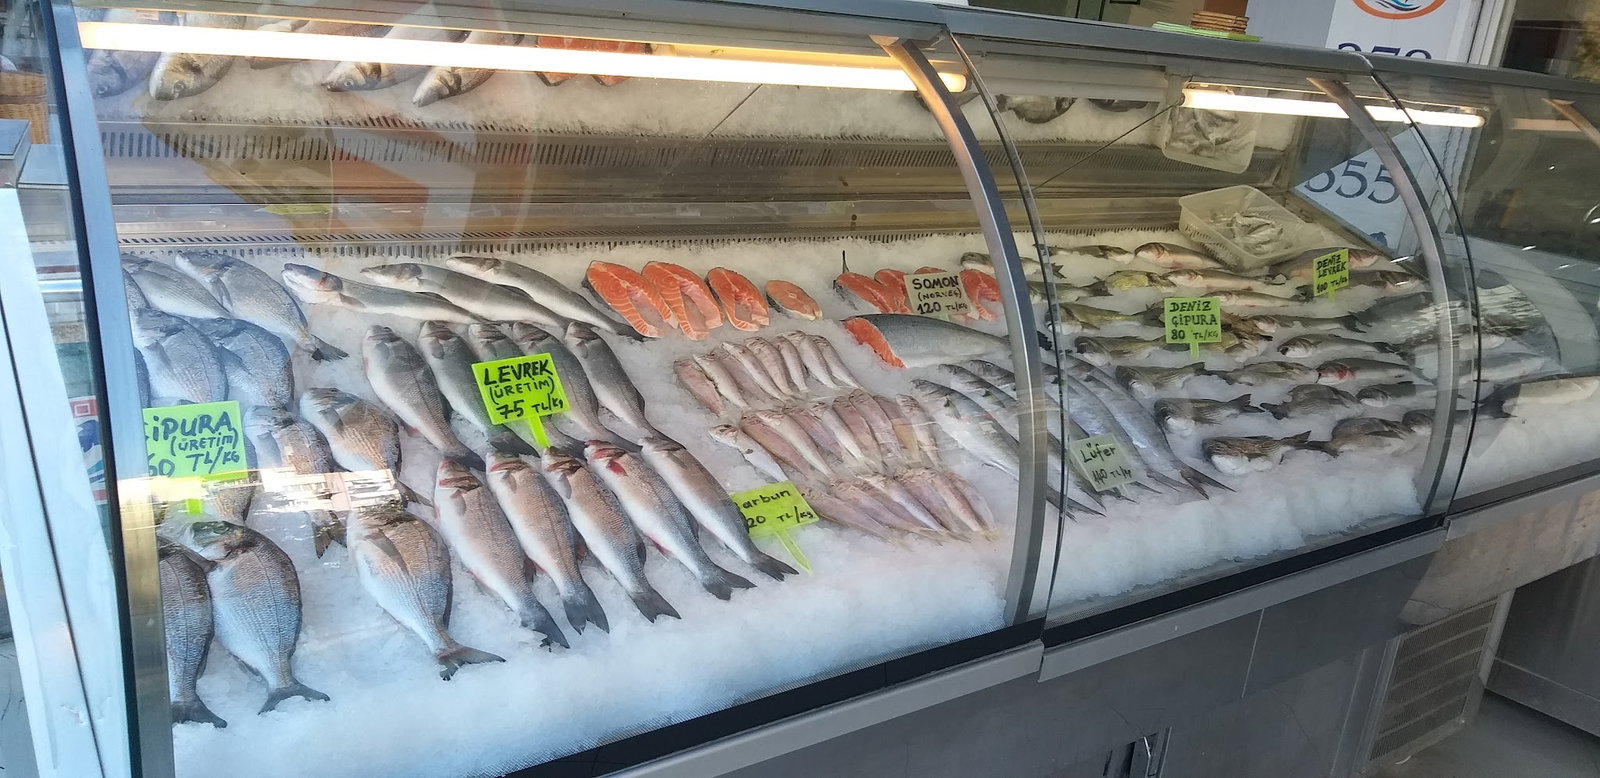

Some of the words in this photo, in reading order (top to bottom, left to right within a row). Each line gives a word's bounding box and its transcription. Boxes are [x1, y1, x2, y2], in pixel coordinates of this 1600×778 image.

[1318, 262, 1347, 278] LEVREK
[912, 276, 959, 290] SOMON
[917, 302, 942, 315] 120
[1169, 300, 1212, 312] DENİZ
[1171, 314, 1218, 328] ÇİPURA
[1171, 329, 1186, 340] 80
[484, 359, 554, 386] LEVREK
[489, 375, 556, 406] (ÜRETİM)
[496, 399, 525, 419] 75
[145, 411, 233, 442] İPURA
[170, 427, 239, 457] (ÜRETİM)
[185, 446, 241, 475] TL/KG
[1080, 442, 1116, 463] Lüfer
[734, 489, 791, 510] arbun
